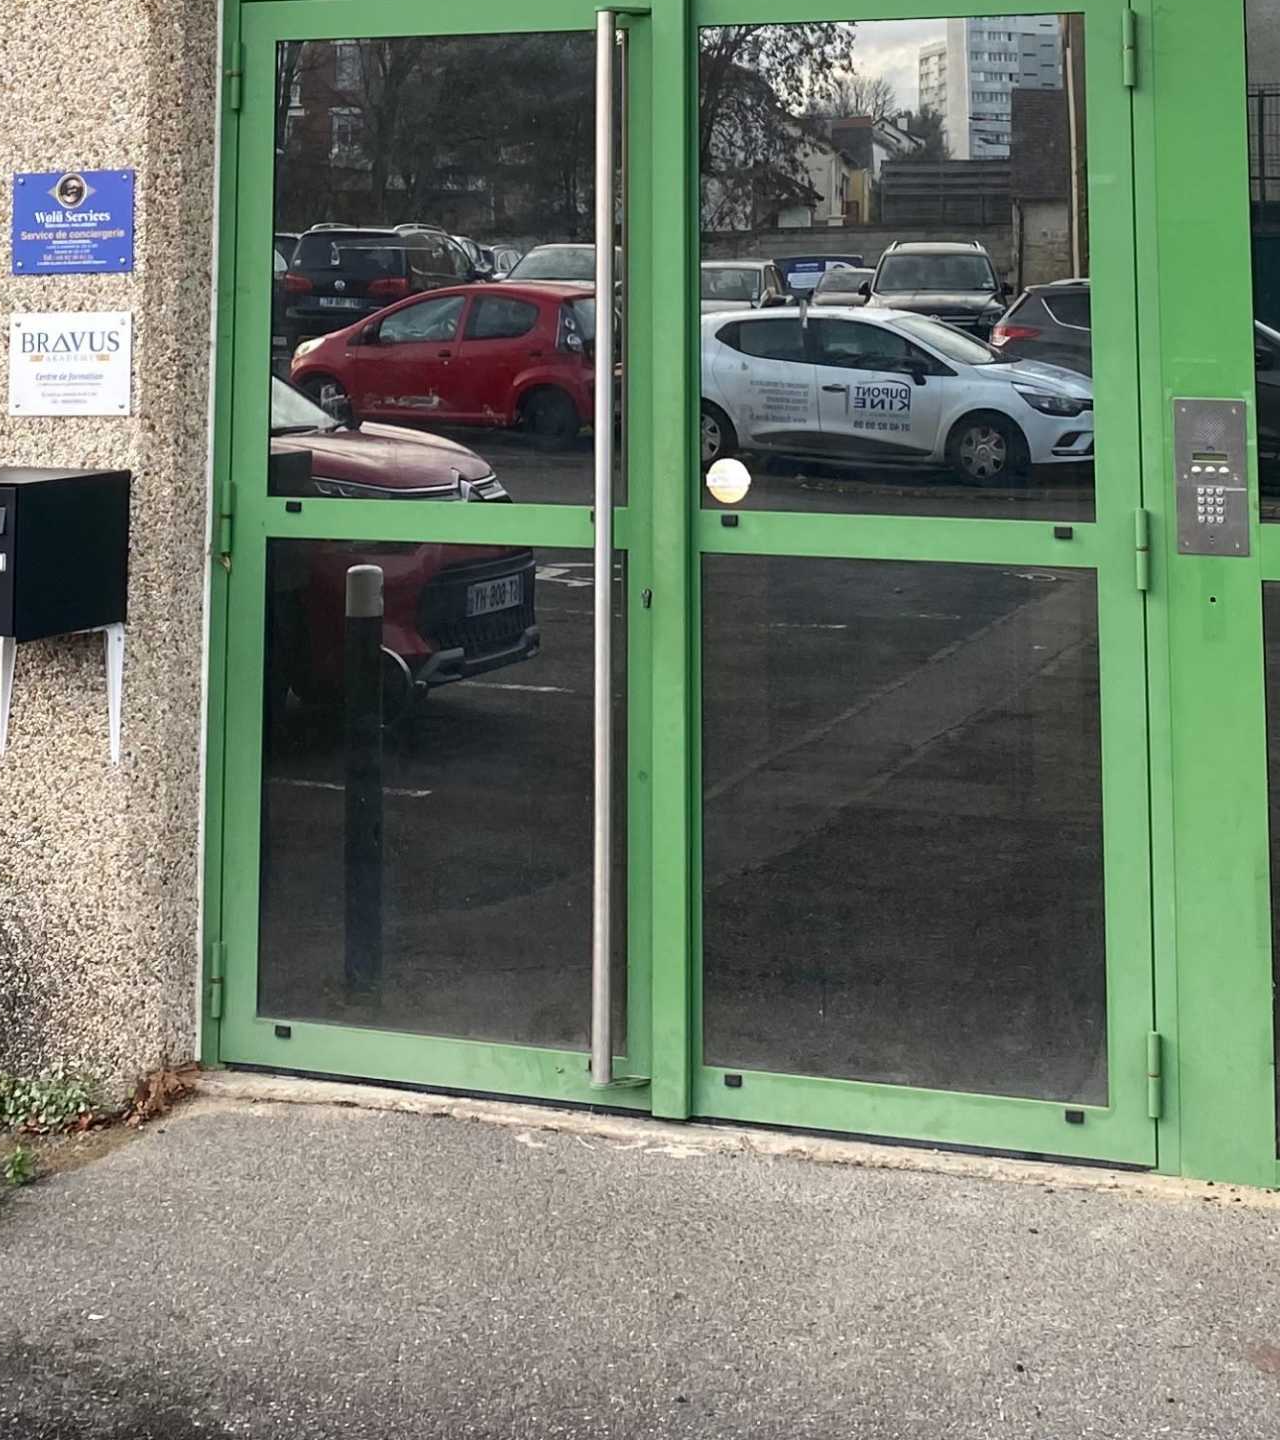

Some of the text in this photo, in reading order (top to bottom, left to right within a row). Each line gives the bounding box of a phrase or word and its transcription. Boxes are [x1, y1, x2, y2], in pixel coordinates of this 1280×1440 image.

[65, 210, 111, 222] Services
[21, 228, 125, 240] Service de conciergerie
[21, 331, 120, 353] BRAVUS
[35, 372, 104, 381] Centre de formation
